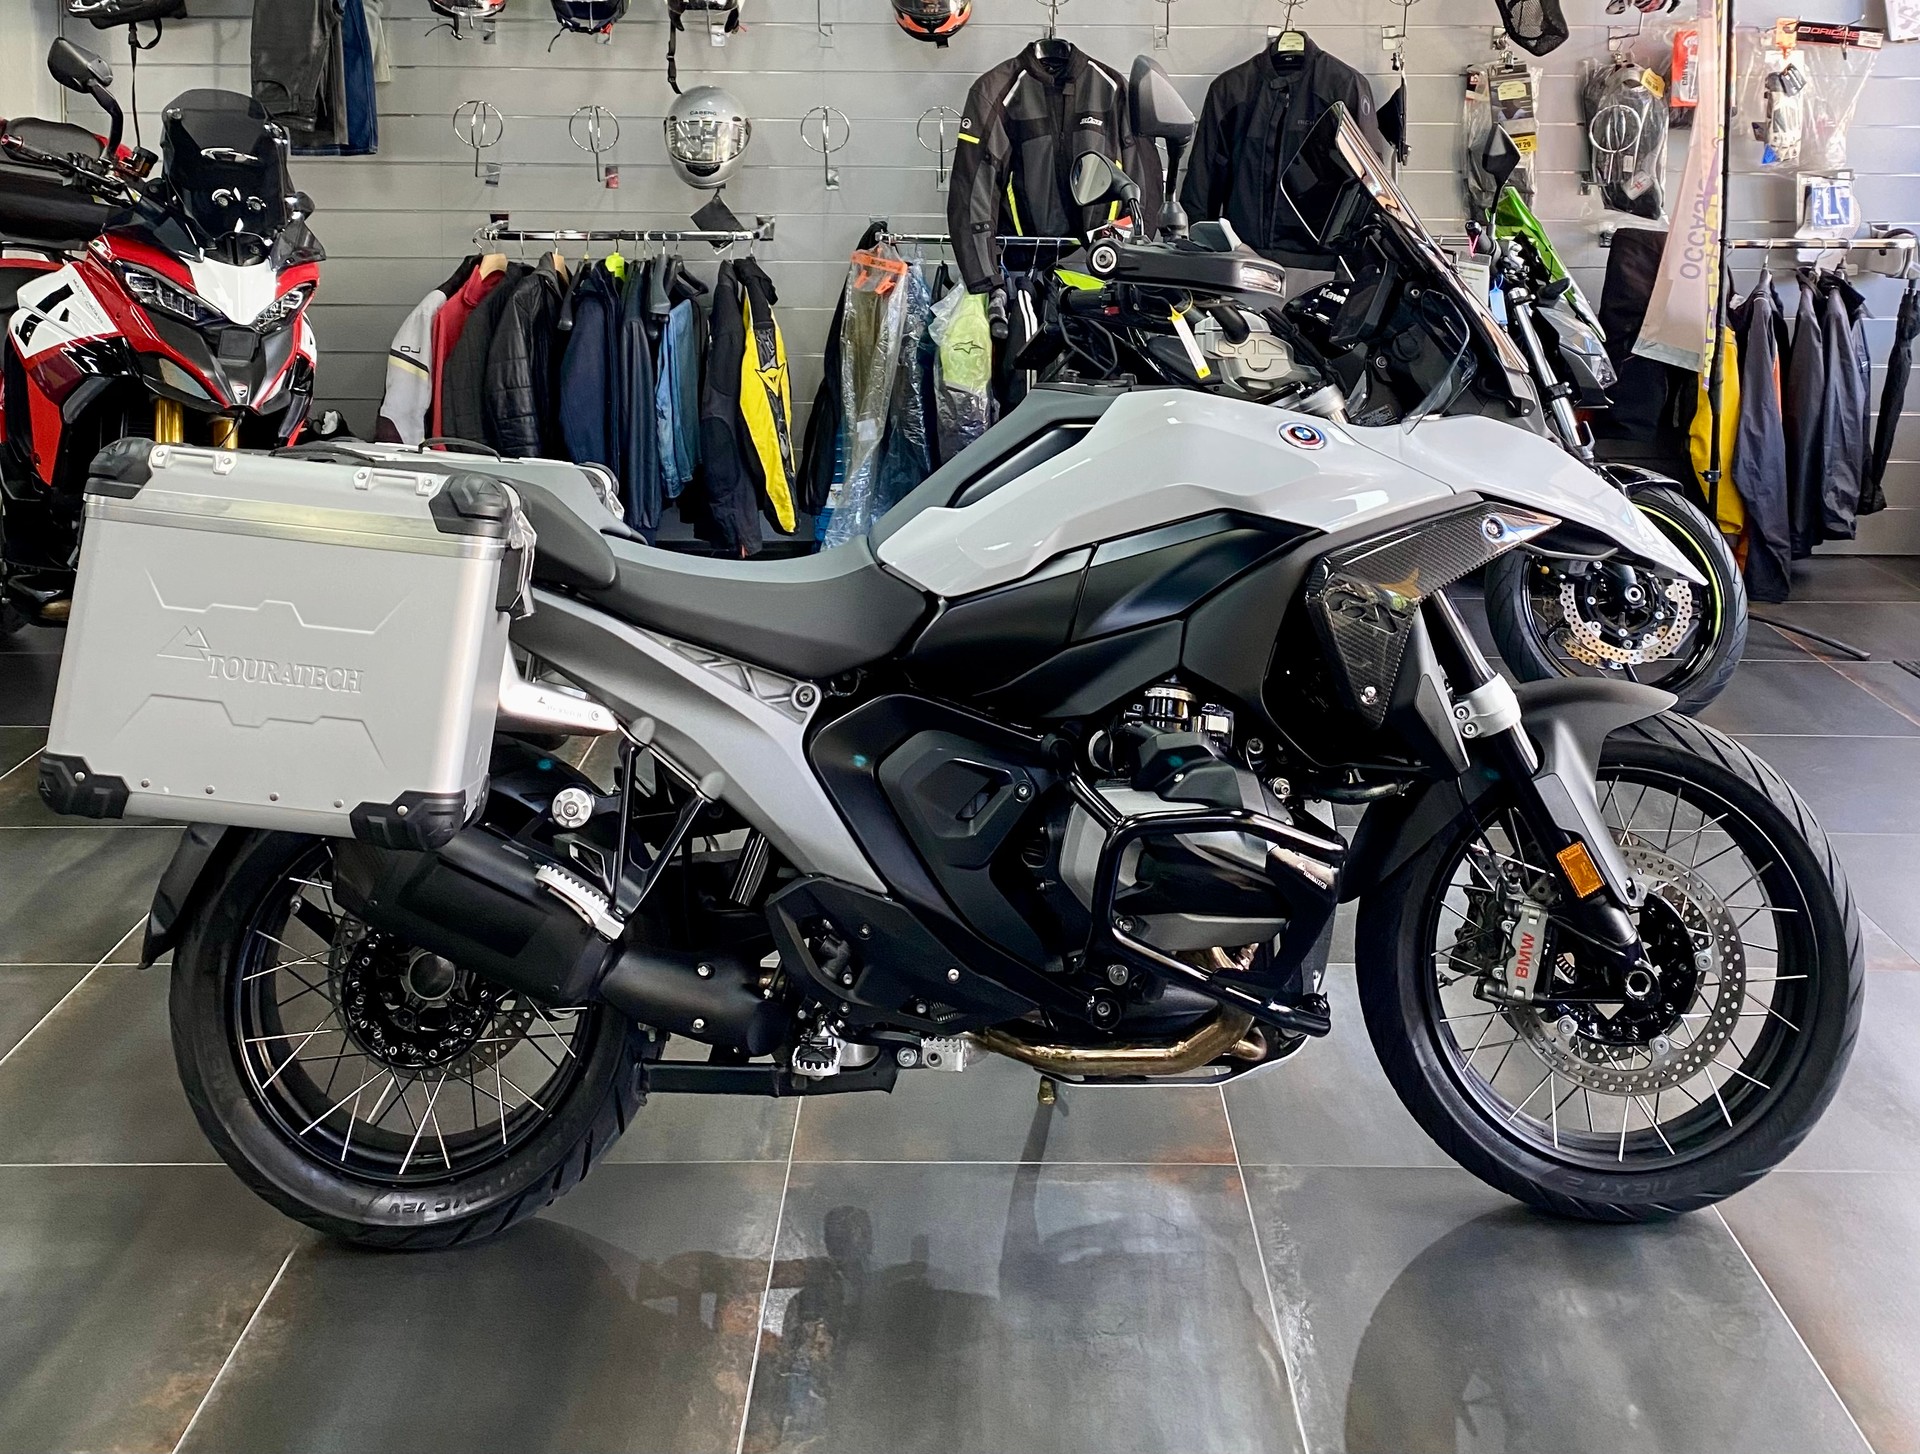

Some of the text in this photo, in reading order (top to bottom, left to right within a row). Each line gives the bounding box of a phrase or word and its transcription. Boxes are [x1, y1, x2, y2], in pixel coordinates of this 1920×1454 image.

[1810, 27, 1860, 39] ORIGINE
[208, 654, 365, 694] TOURATECH
[1515, 931, 1535, 979] BMW
